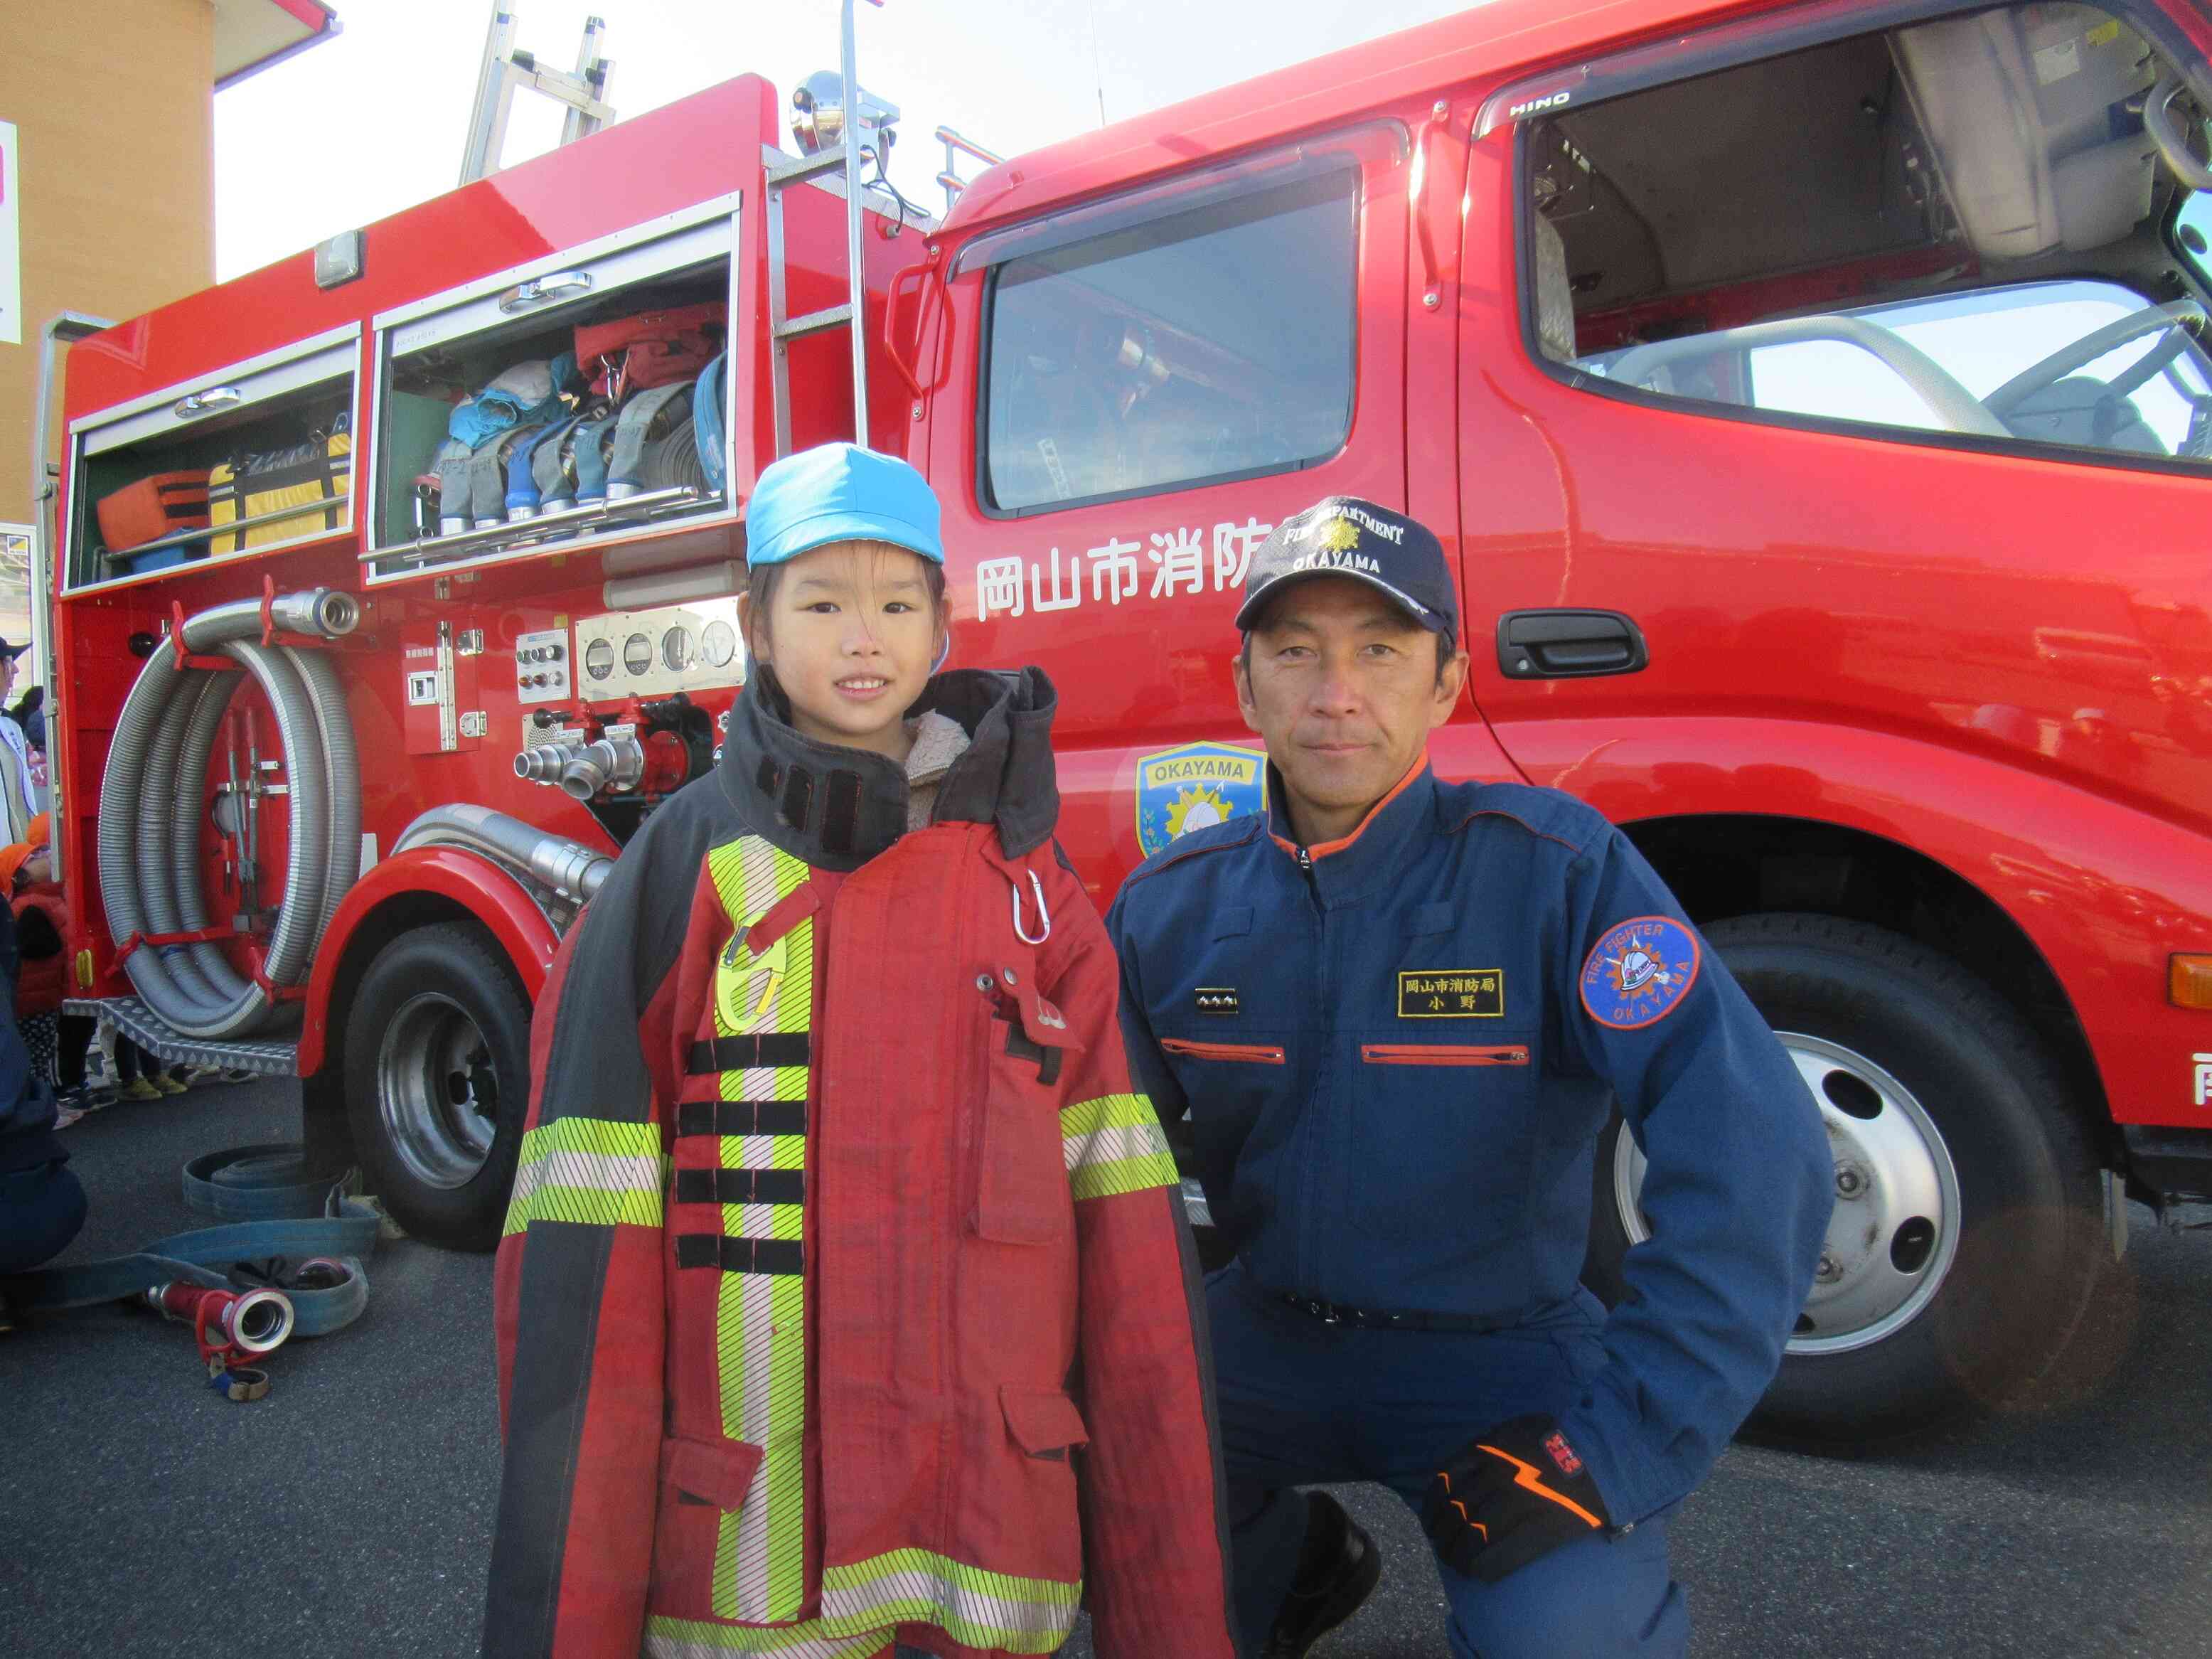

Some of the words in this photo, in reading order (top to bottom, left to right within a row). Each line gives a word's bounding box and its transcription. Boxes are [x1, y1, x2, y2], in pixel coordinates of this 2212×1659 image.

[1510, 92, 1570, 116] HINO
[1315, 506, 1404, 545] PARTMENT
[977, 517, 1273, 622] 岡山市消防
[1293, 551, 1381, 573] OKAYAMA
[1155, 761, 1244, 781] OKAYAMA
[1586, 952, 1605, 984] FIRE
[1604, 924, 1664, 953] FIGHTER
[1405, 978, 1495, 994] 岡山市消防局
[1613, 961, 1689, 1020] OKAYAMA
